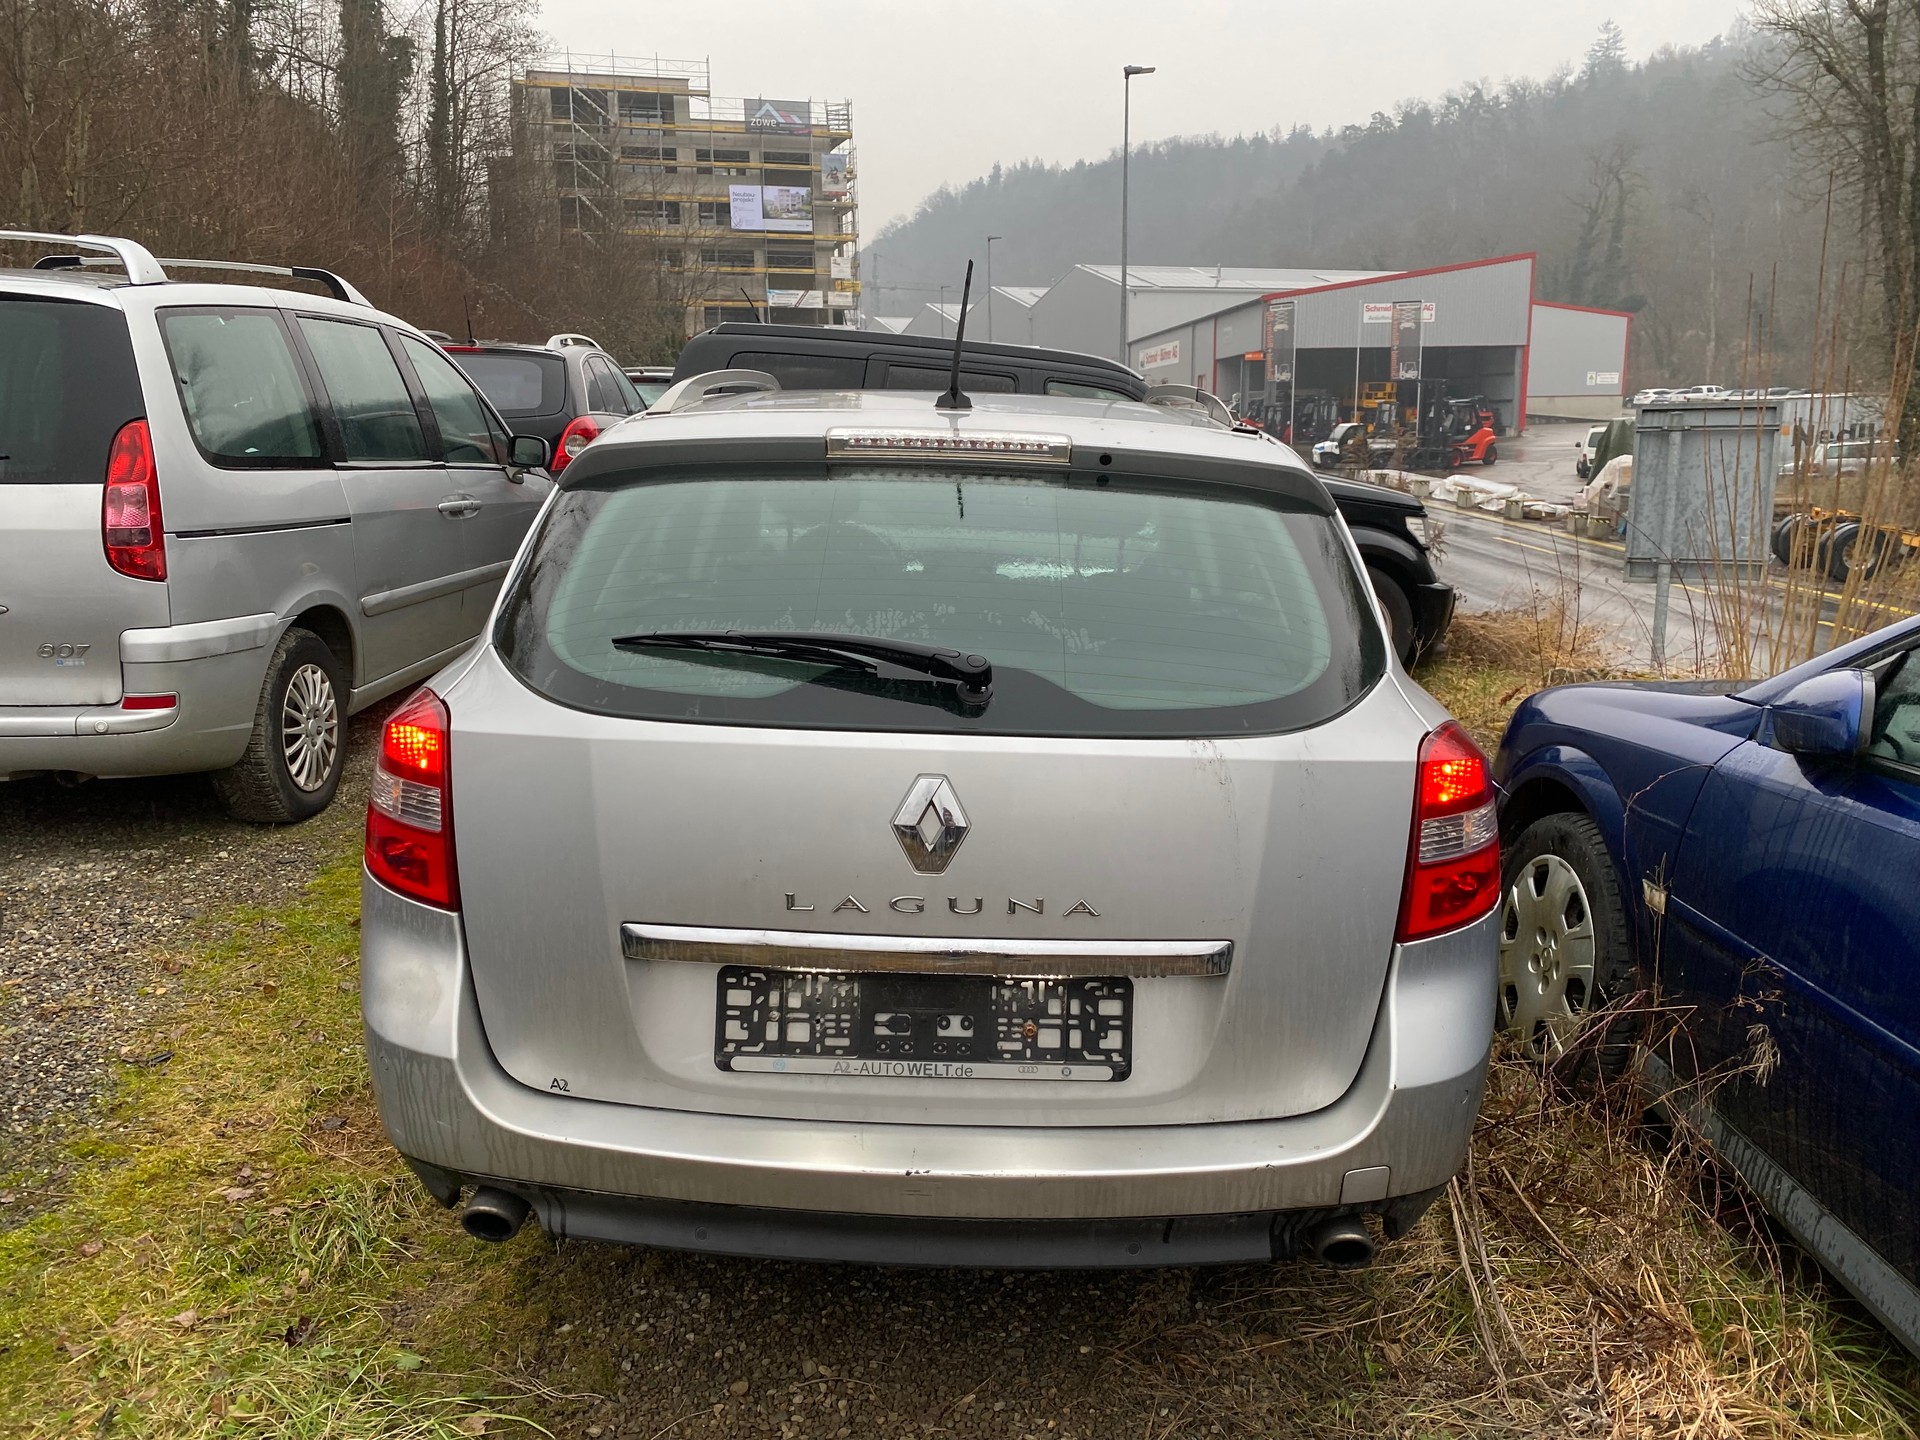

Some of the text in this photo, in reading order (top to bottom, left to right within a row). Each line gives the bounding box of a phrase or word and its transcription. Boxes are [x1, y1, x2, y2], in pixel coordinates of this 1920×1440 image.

[1365, 304, 1392, 312] Schmid
[37, 642, 91, 658] 807
[785, 892, 1101, 917] LAGUNA
